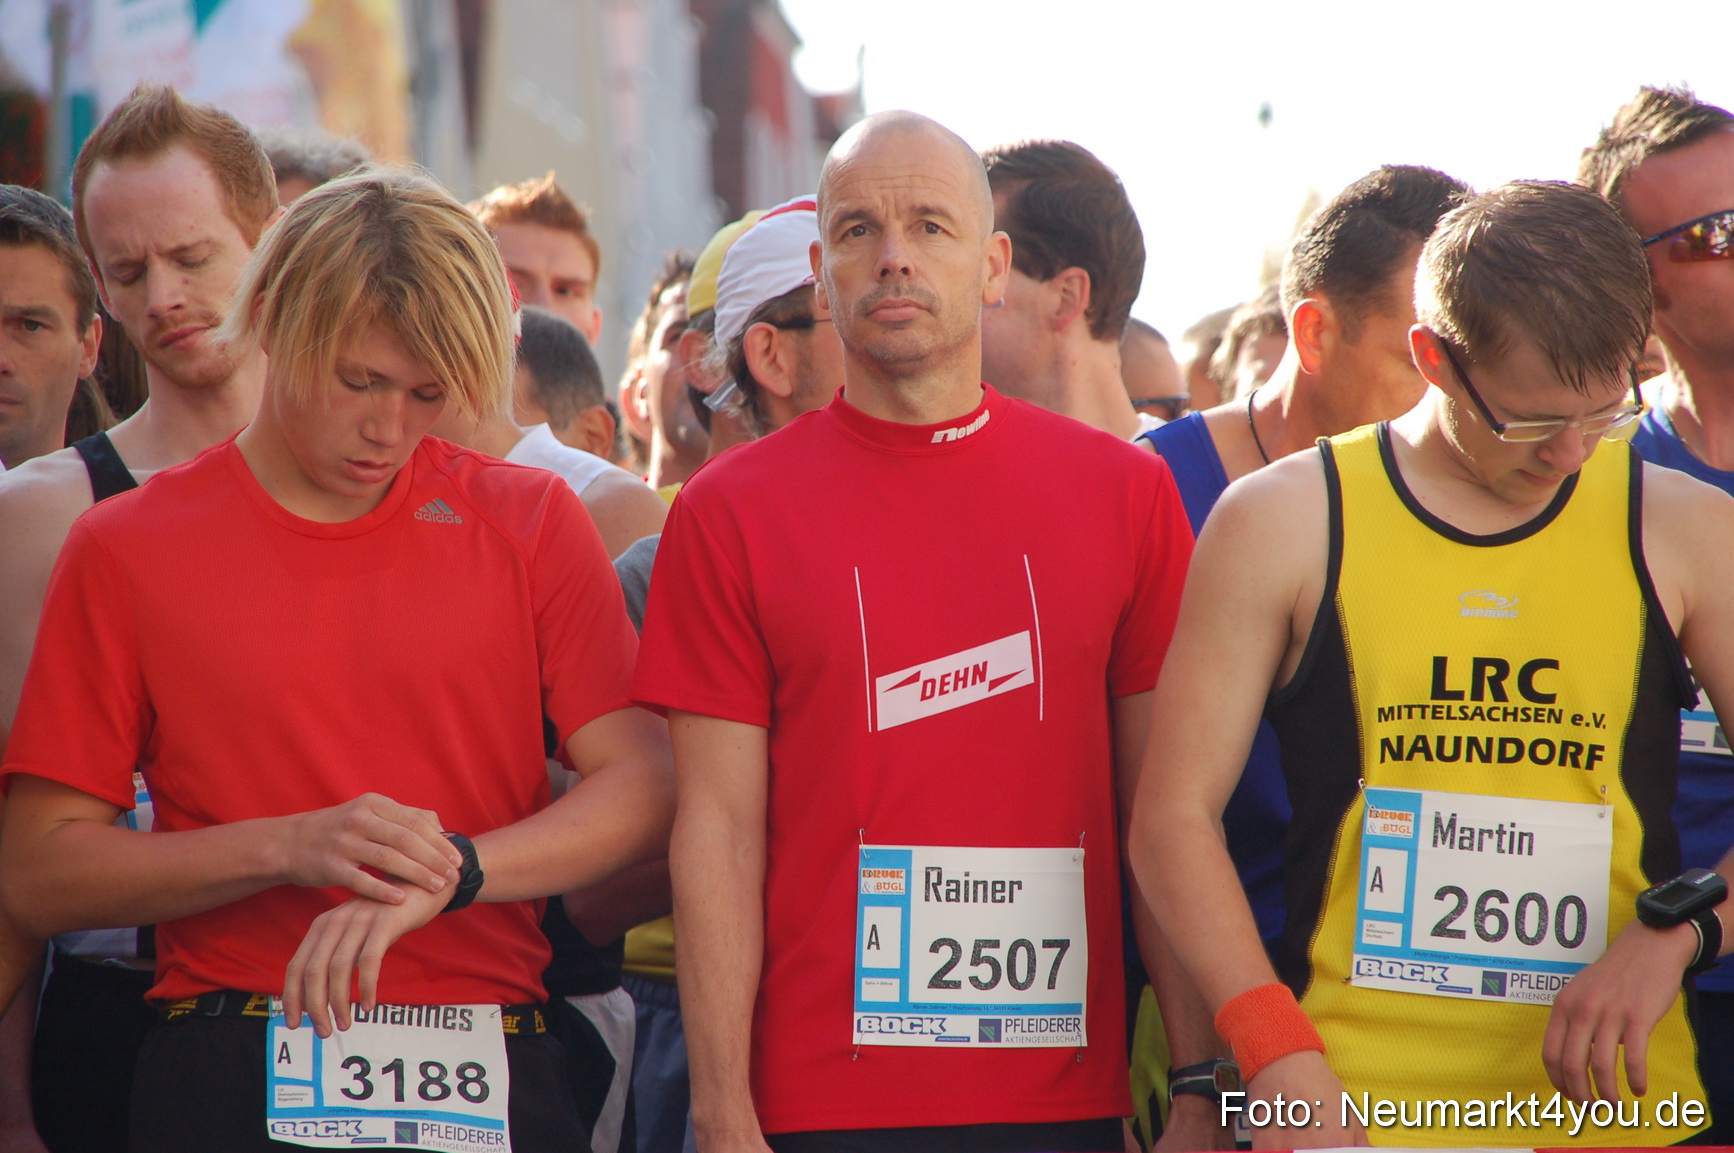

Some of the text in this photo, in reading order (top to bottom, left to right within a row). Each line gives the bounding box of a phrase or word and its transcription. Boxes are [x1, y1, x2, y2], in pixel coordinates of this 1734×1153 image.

[414, 511, 463, 524] adidas
[1459, 605, 1519, 619] biemme
[920, 660, 988, 702] DEHN
[1430, 656, 1560, 705] LRC
[1377, 703, 1607, 730] MITTELSACHSEN e.V.
[1380, 734, 1606, 771] NAUNDORF
[1369, 809, 1413, 822] DRUCK
[1432, 811, 1534, 856] Martin
[862, 869, 904, 879] DRUCK
[924, 866, 1023, 904] Rainer
[1370, 866, 1384, 893] A
[1430, 885, 1588, 949] 2600
[866, 924, 881, 950] A
[927, 937, 1071, 991] 2507
[1356, 958, 1449, 984] BOCK
[1510, 973, 1575, 991] PFLEIDE
[1510, 992, 1556, 1002] AKTIENGES
[354, 1003, 473, 1032] ohannes
[857, 1015, 947, 1035] BOCK
[1005, 1017, 1081, 1033] PFLEIDERER
[277, 1041, 291, 1064] A
[340, 1055, 490, 1104] 3188
[271, 1120, 363, 1137] BOCK
[421, 1123, 505, 1146] PFLEIDERER
